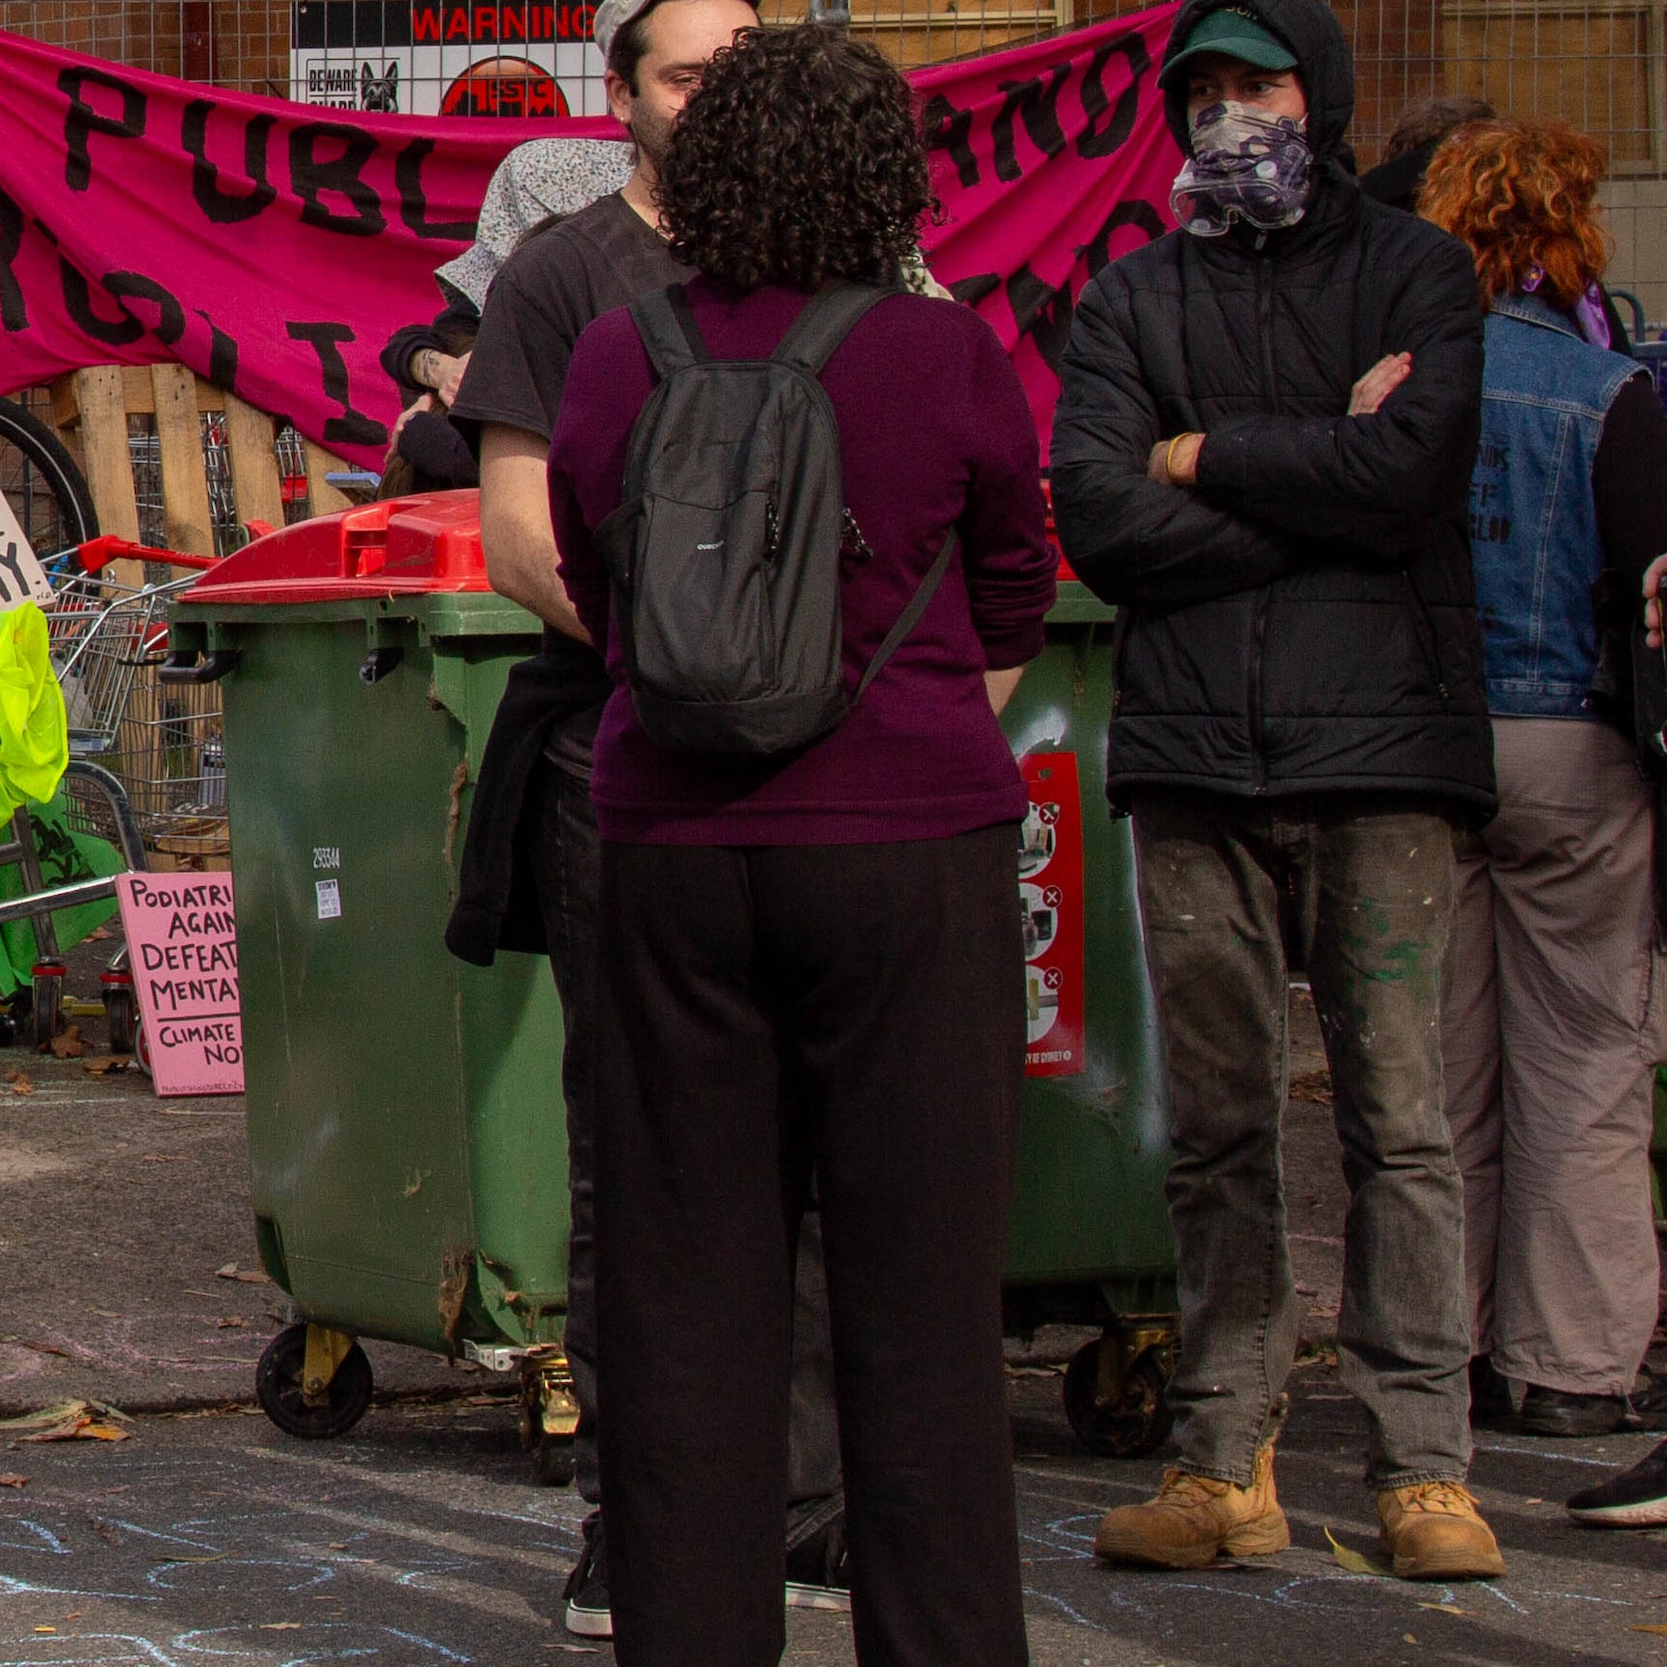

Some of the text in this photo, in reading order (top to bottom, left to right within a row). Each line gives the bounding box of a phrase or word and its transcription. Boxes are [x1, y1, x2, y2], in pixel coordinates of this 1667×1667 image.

[412, 5, 598, 40] WARNING
[309, 69, 357, 92] BEWARE
[57, 65, 480, 240] PUBL
[130, 879, 233, 908] PODIATRI
[168, 911, 236, 939] AGAIN
[141, 940, 237, 972] DEFEAT
[149, 976, 240, 1011] MENTA
[160, 1023, 236, 1048] CLIMATE
[204, 1045, 244, 1066] NO
